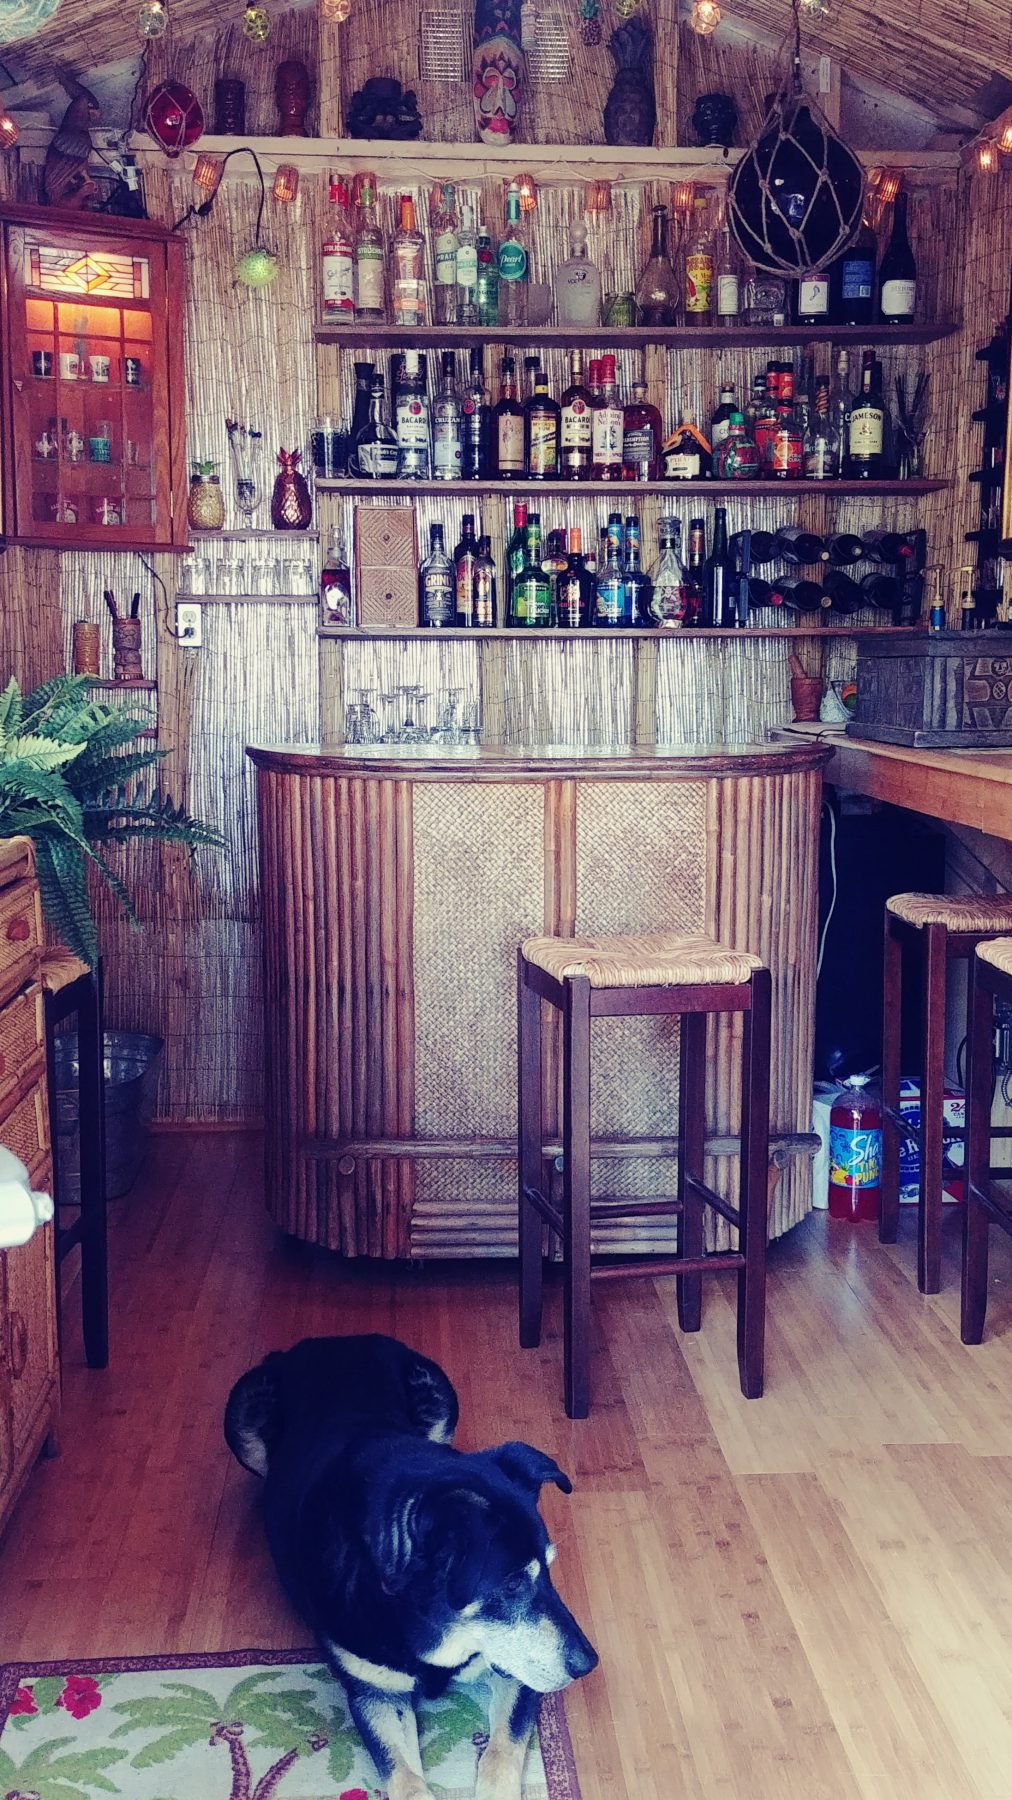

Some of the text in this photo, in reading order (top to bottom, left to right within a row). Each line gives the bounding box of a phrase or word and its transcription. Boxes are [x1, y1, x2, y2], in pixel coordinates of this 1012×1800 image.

[500, 254, 522, 266] Pearl
[402, 416, 427, 424] BACARD
[852, 412, 882, 423] JAMESON
[848, 1134, 879, 1166] Sha
